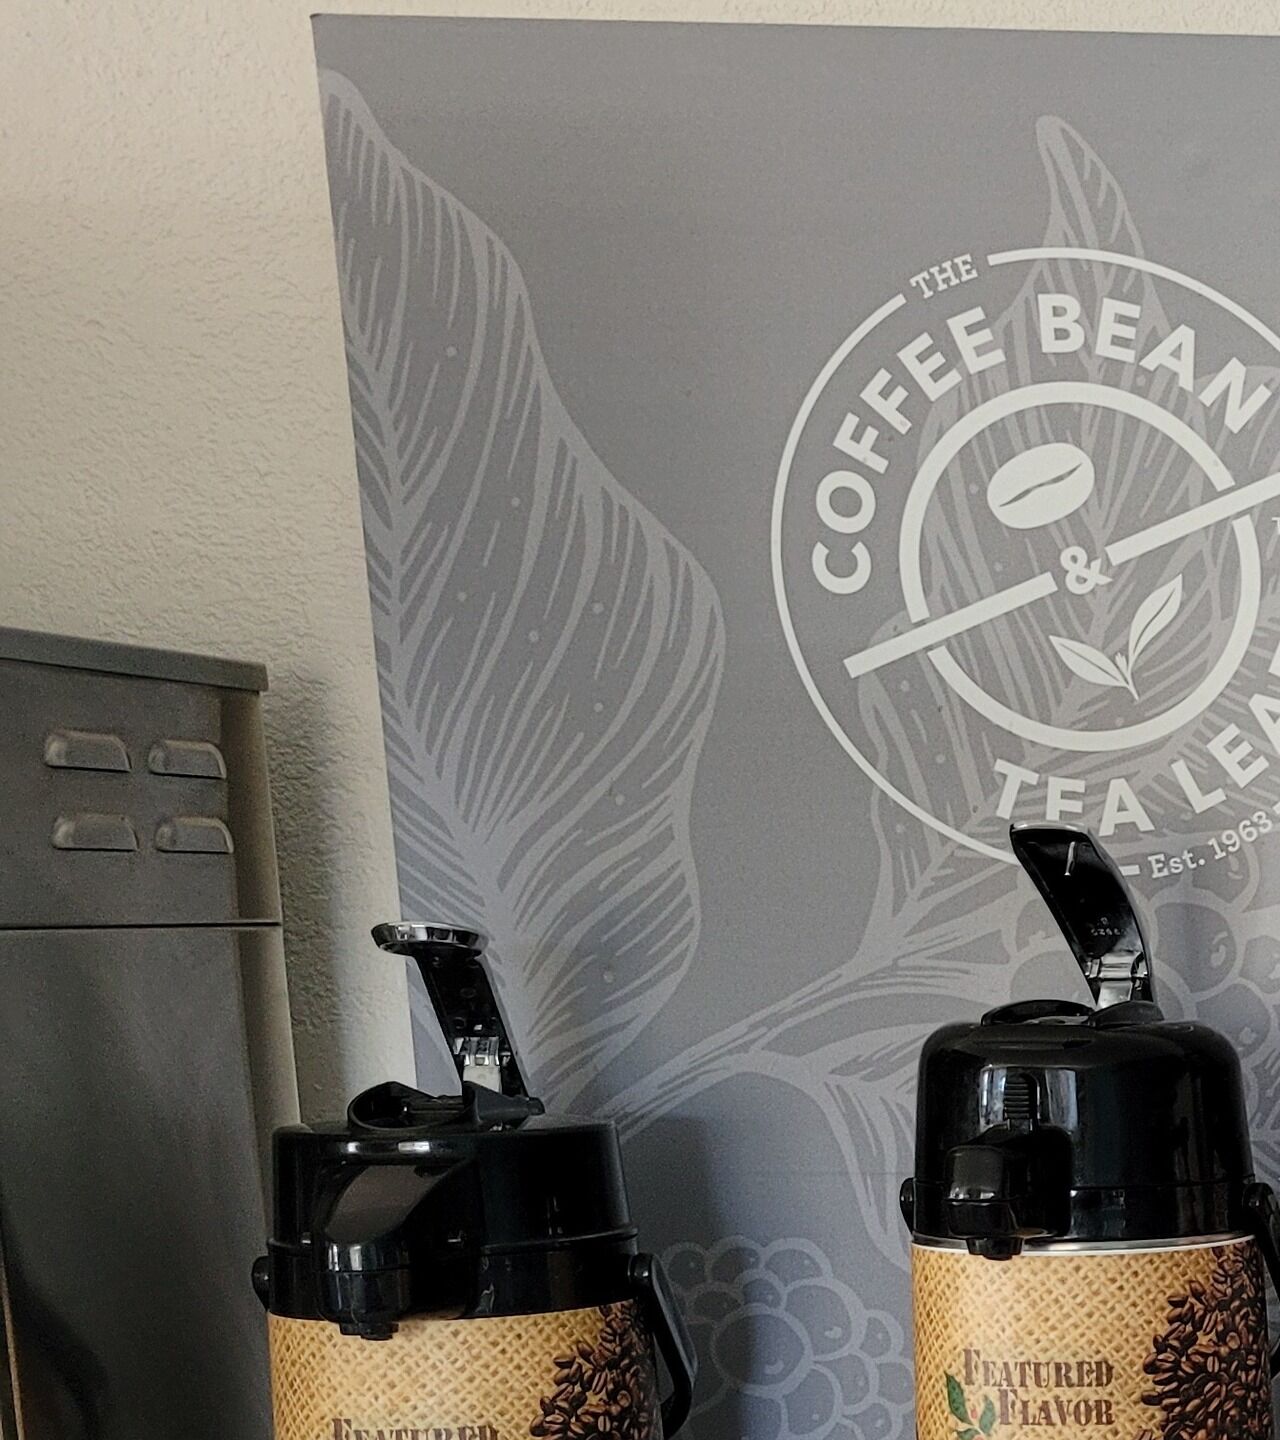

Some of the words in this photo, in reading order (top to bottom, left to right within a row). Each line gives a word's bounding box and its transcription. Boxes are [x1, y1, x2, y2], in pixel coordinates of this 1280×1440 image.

[910, 253, 979, 300] THE
[811, 306, 1006, 596] COFFEE
[1037, 293, 1272, 435] BEAN
[1060, 545, 1113, 594] &
[993, 759, 1155, 837] TEA
[1151, 850, 1206, 879] Est.
[1211, 810, 1275, 861] 1963
